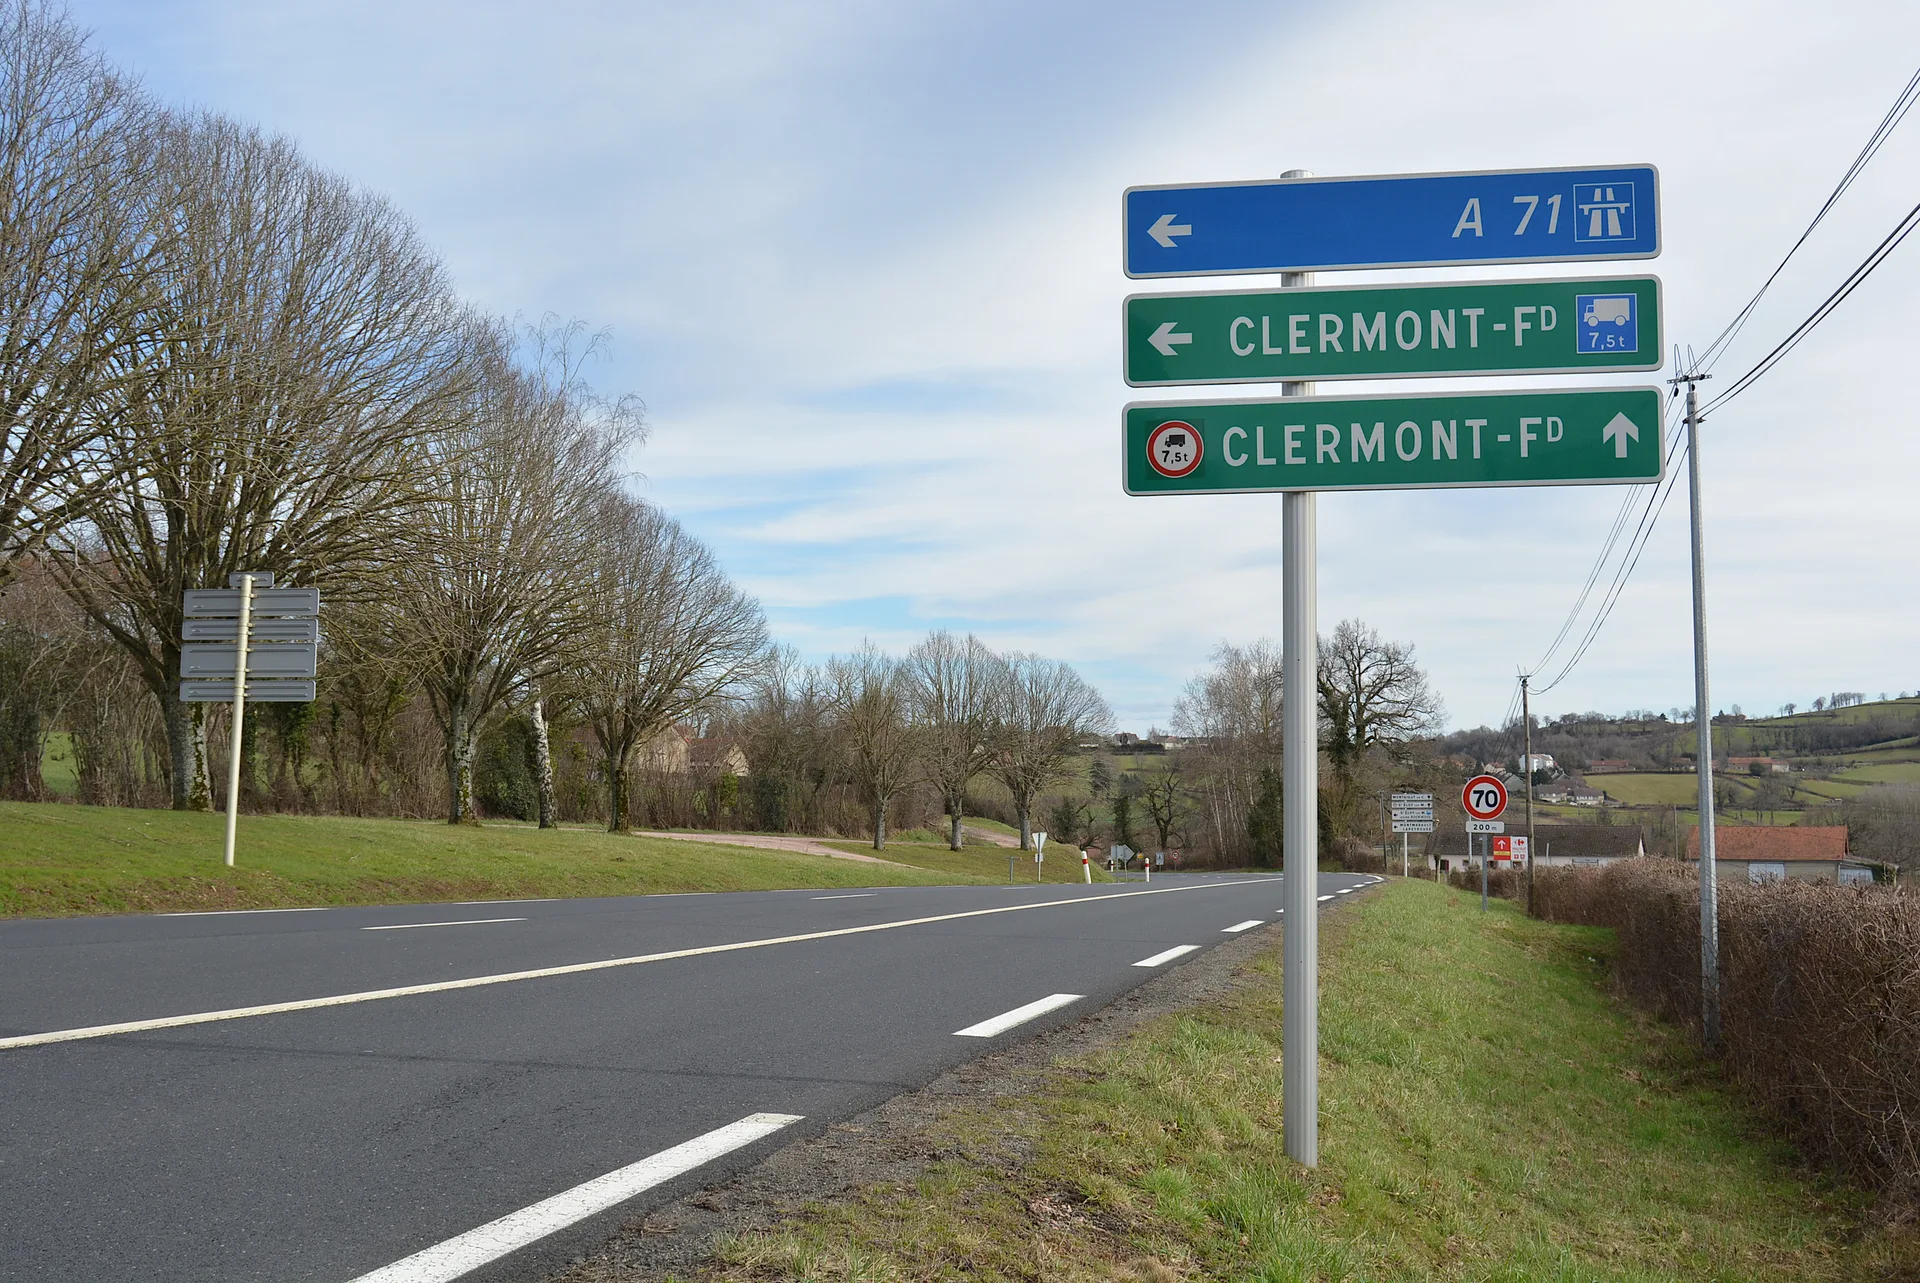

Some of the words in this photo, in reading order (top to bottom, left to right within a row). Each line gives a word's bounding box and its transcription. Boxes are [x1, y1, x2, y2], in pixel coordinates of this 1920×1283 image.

[1452, 197, 1484, 238] A
[1512, 193, 1563, 236] 71
[1229, 305, 1558, 357] CLERMONT-FD
[1222, 416, 1565, 467] CLERMONT-FD
[1473, 790, 1498, 808] 70
